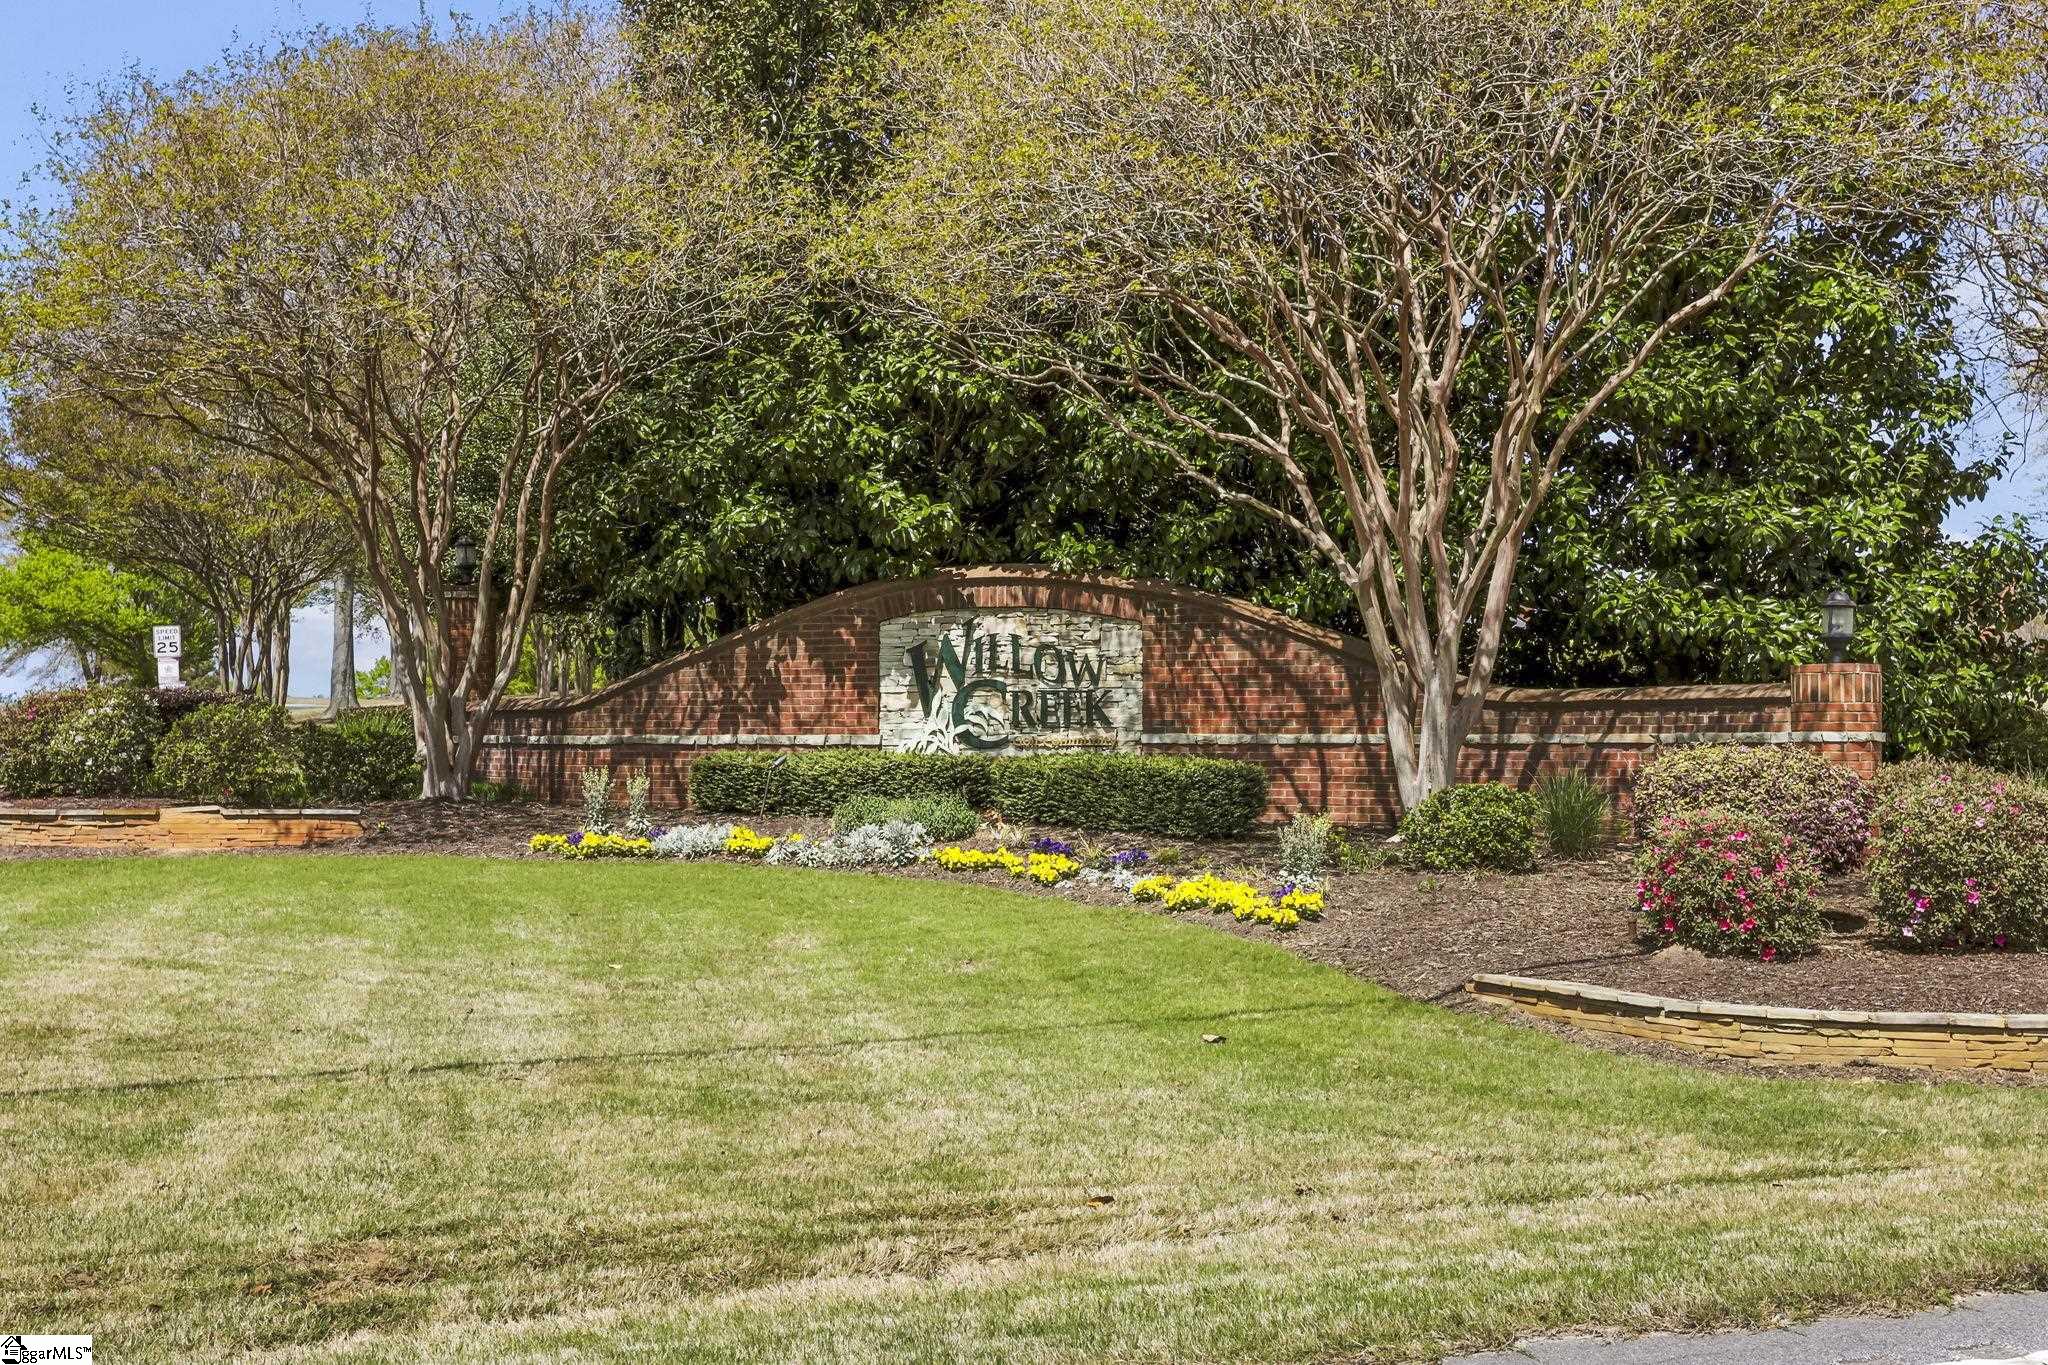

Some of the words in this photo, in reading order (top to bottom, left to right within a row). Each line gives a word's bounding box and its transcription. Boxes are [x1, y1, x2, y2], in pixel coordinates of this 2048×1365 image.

[157, 641, 179, 654] 25
[906, 615, 1107, 718] WILLOW
[951, 679, 1114, 749] CREEK
